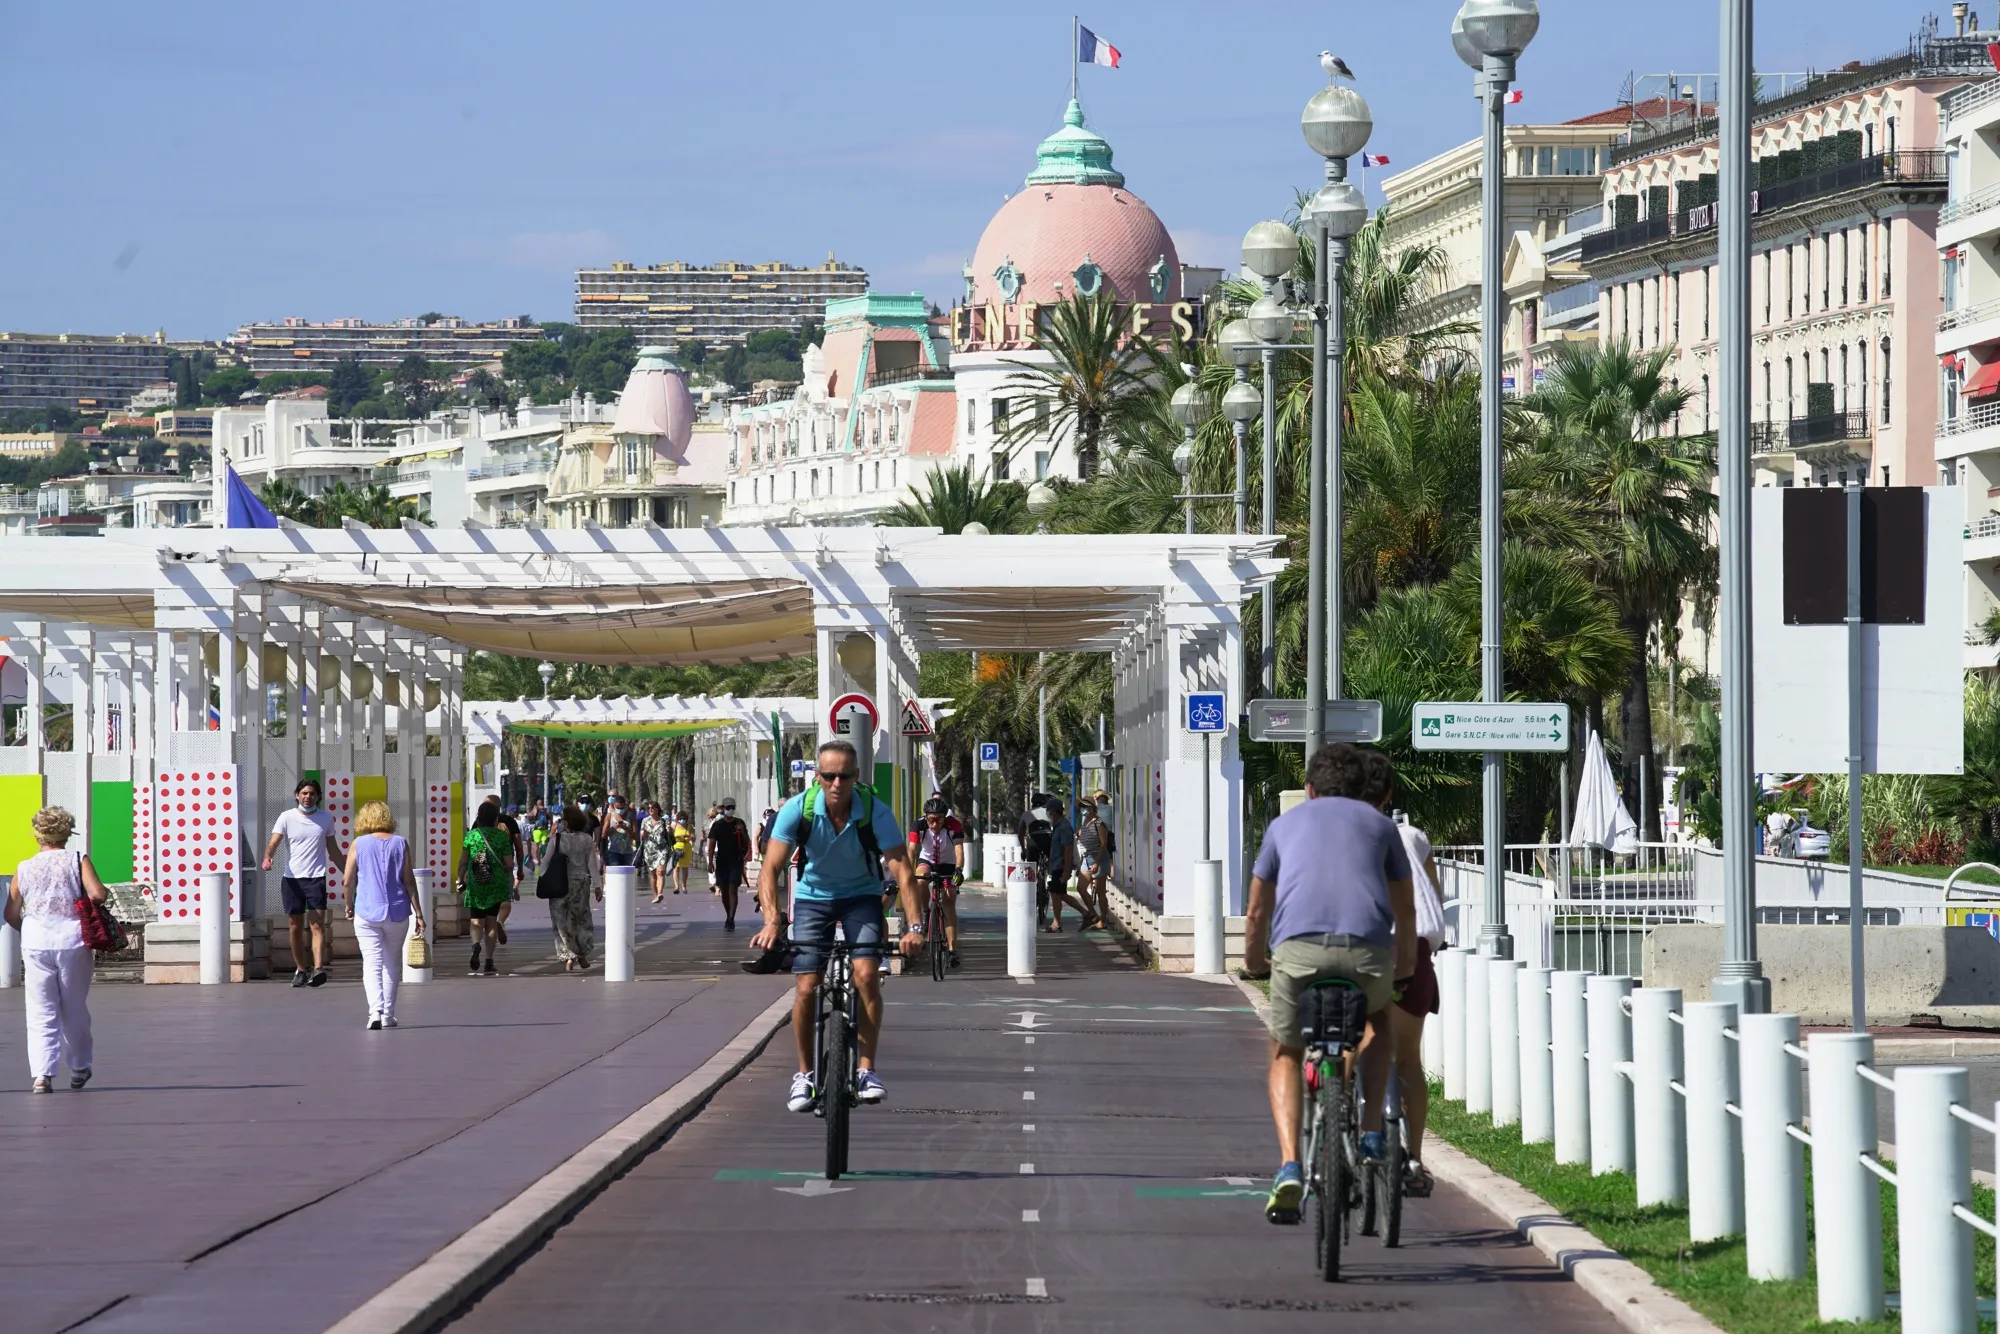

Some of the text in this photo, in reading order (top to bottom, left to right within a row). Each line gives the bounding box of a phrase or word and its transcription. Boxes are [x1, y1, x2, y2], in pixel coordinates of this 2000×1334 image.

[1689, 204, 1710, 231] HOTEL
[1456, 715, 1472, 723] Nice
[1474, 715, 1491, 723] Côte
[1492, 715, 1515, 723] d'Azur
[1536, 715, 1546, 723] km
[1445, 731, 1461, 739] Gare
[1536, 731, 1547, 739] km
